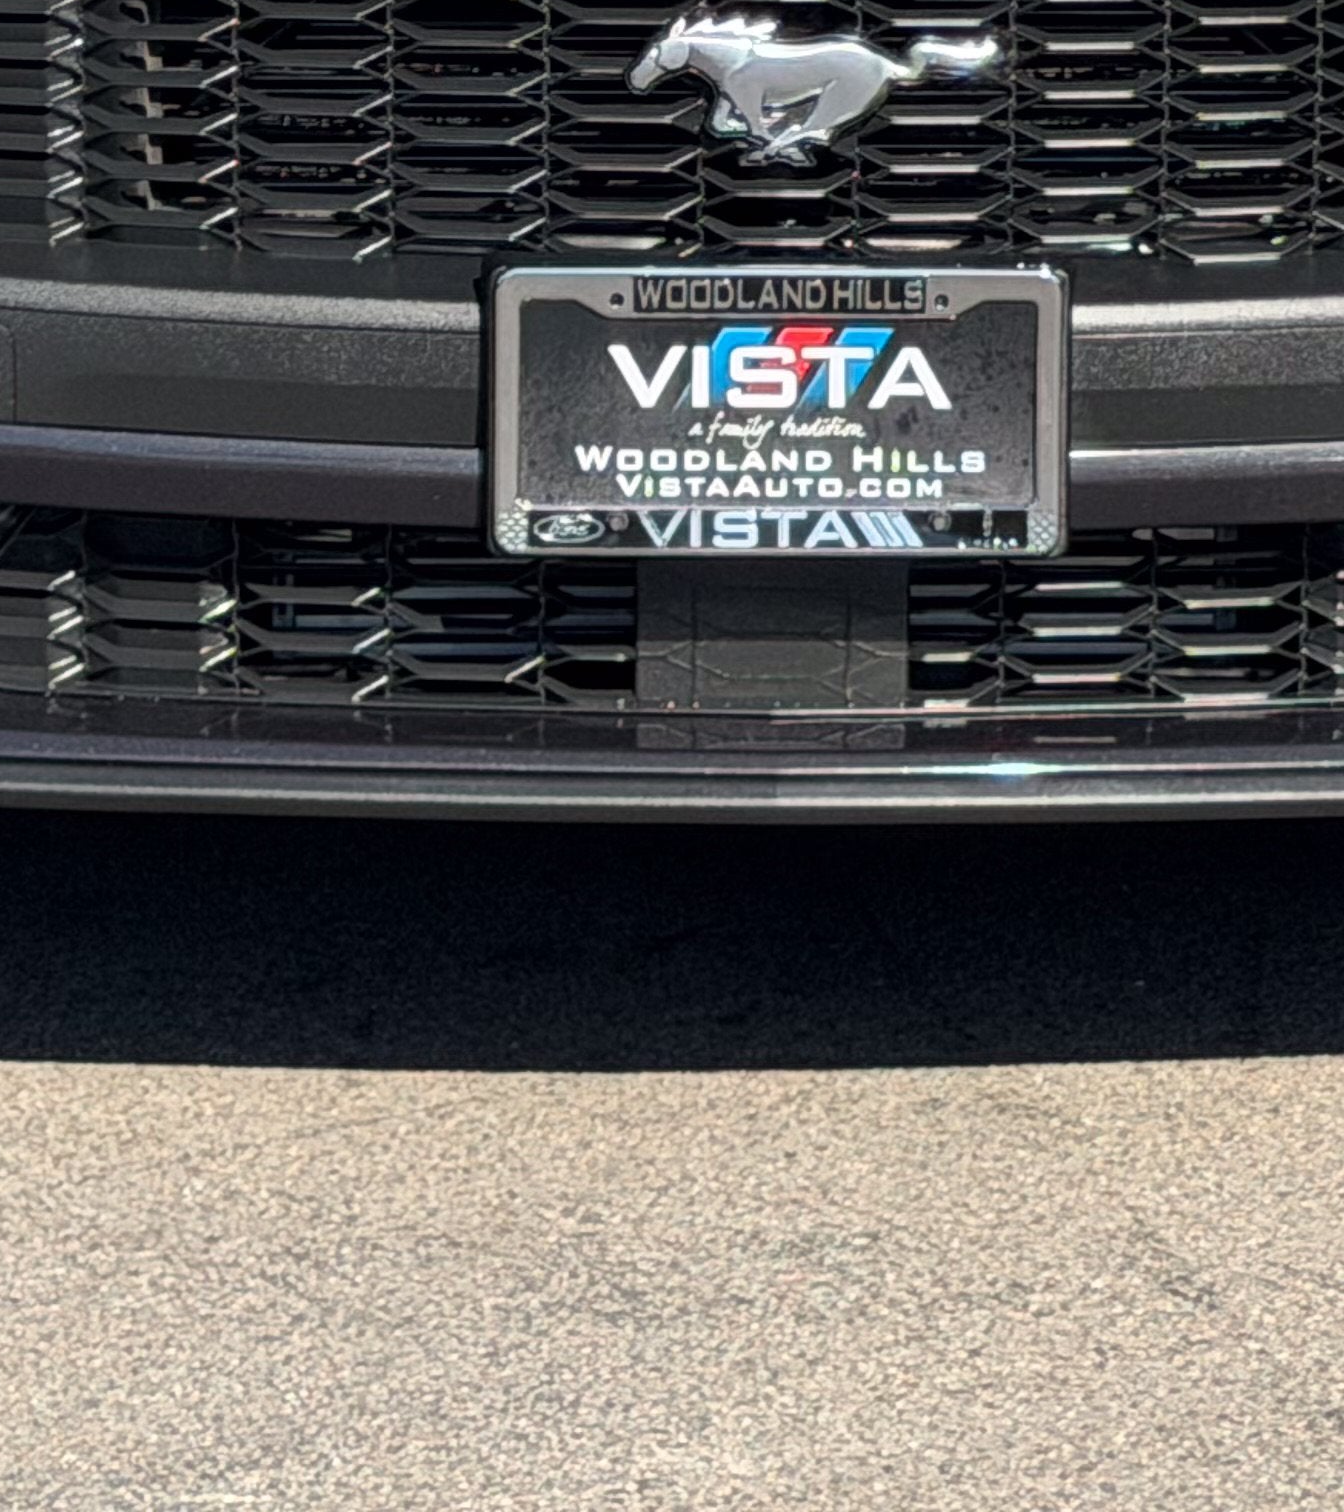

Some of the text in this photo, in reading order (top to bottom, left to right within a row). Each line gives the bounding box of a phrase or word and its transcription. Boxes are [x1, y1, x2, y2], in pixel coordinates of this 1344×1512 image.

[637, 278, 924, 312] WOODLAND HILLS
[607, 344, 953, 410] VISTA
[704, 410, 775, 450] family
[779, 413, 867, 438] tradition
[574, 445, 987, 474] WOODLAND HILLS
[637, 509, 860, 549] VISTA
